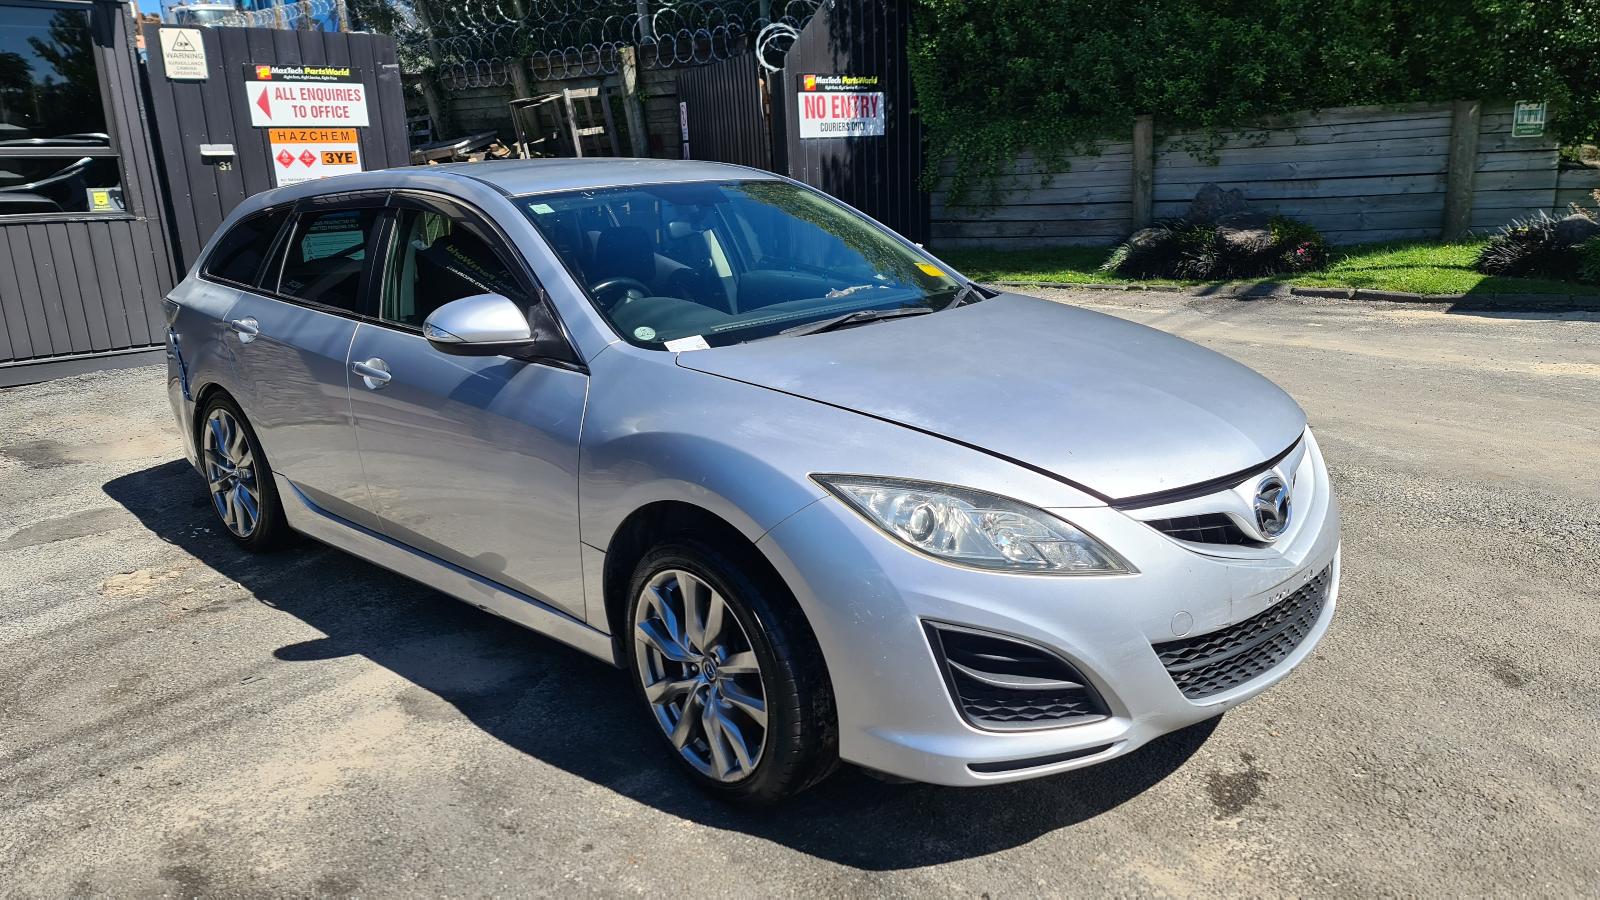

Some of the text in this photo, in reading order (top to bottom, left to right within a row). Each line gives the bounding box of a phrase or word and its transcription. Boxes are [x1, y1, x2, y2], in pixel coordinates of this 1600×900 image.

[304, 67, 350, 76] PartsWorld
[842, 75, 878, 84] PartsWorld
[275, 87, 361, 102] ALL ENQUIRIES
[292, 105, 350, 119] TO OFFICE
[804, 95, 878, 119] NO ENTRY
[820, 121, 866, 132] COURIERS ONLY
[277, 131, 350, 141] HAZCHEM
[325, 152, 354, 164] 3YE
[219, 161, 232, 171] 31
